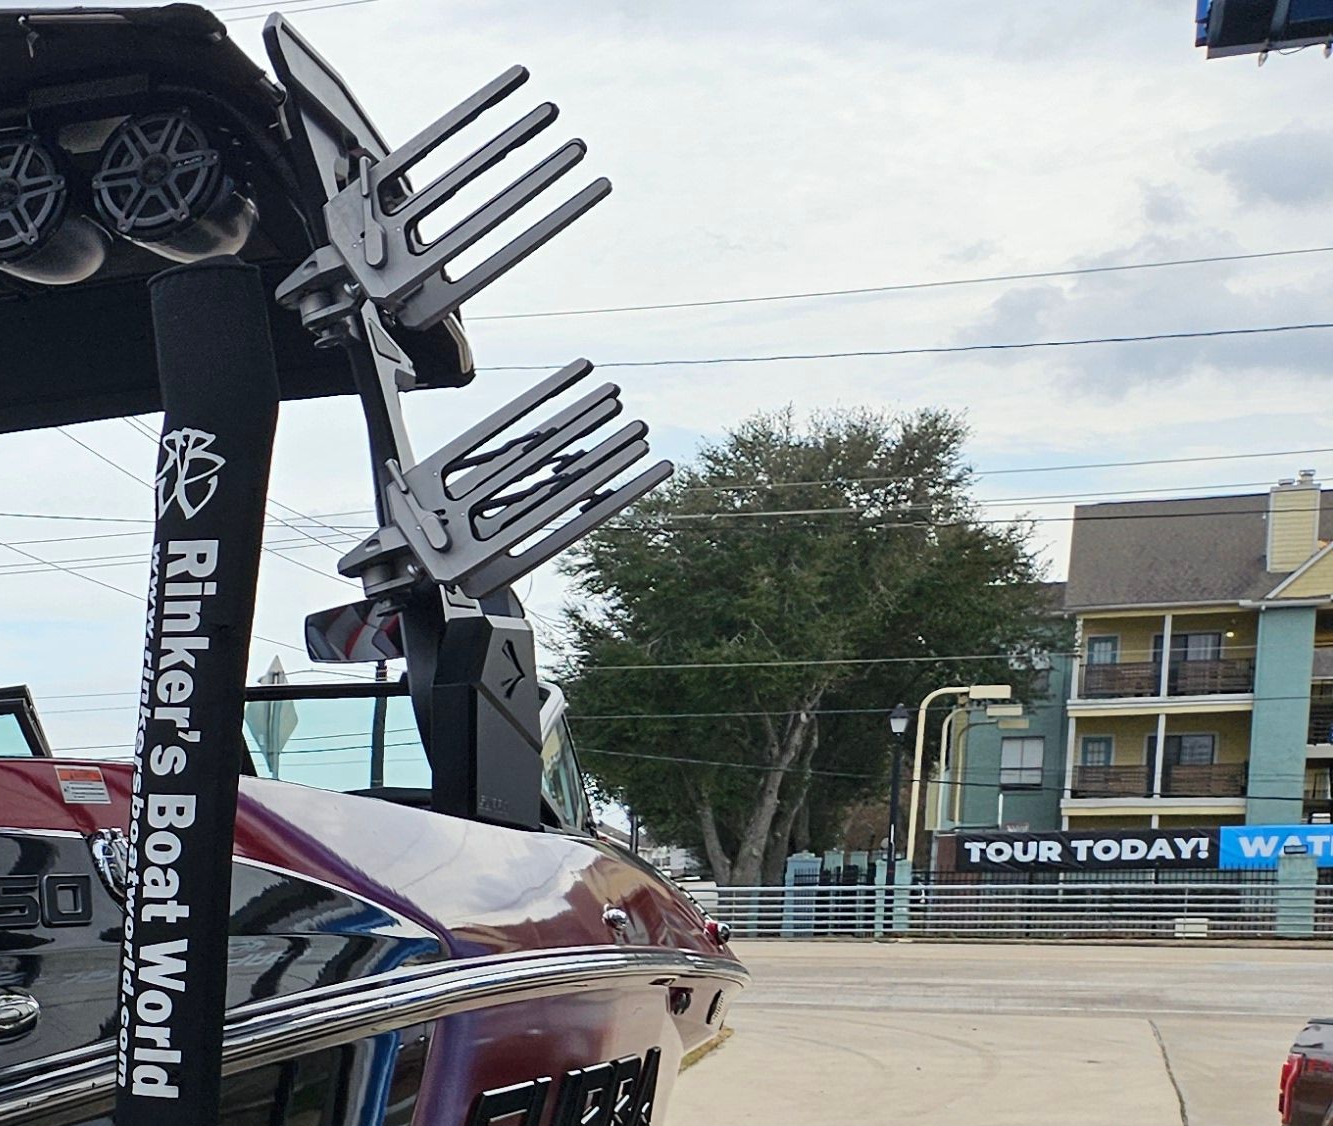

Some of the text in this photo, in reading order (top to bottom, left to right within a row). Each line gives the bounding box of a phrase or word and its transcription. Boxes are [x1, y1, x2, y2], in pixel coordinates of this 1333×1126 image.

[117, 542, 162, 1088] www.rinkersboatworld.com
[132, 539, 219, 1099] Rinker's Boat World
[964, 837, 1210, 863] TOUR TODAY!
[1238, 835, 1333, 858] WAT
